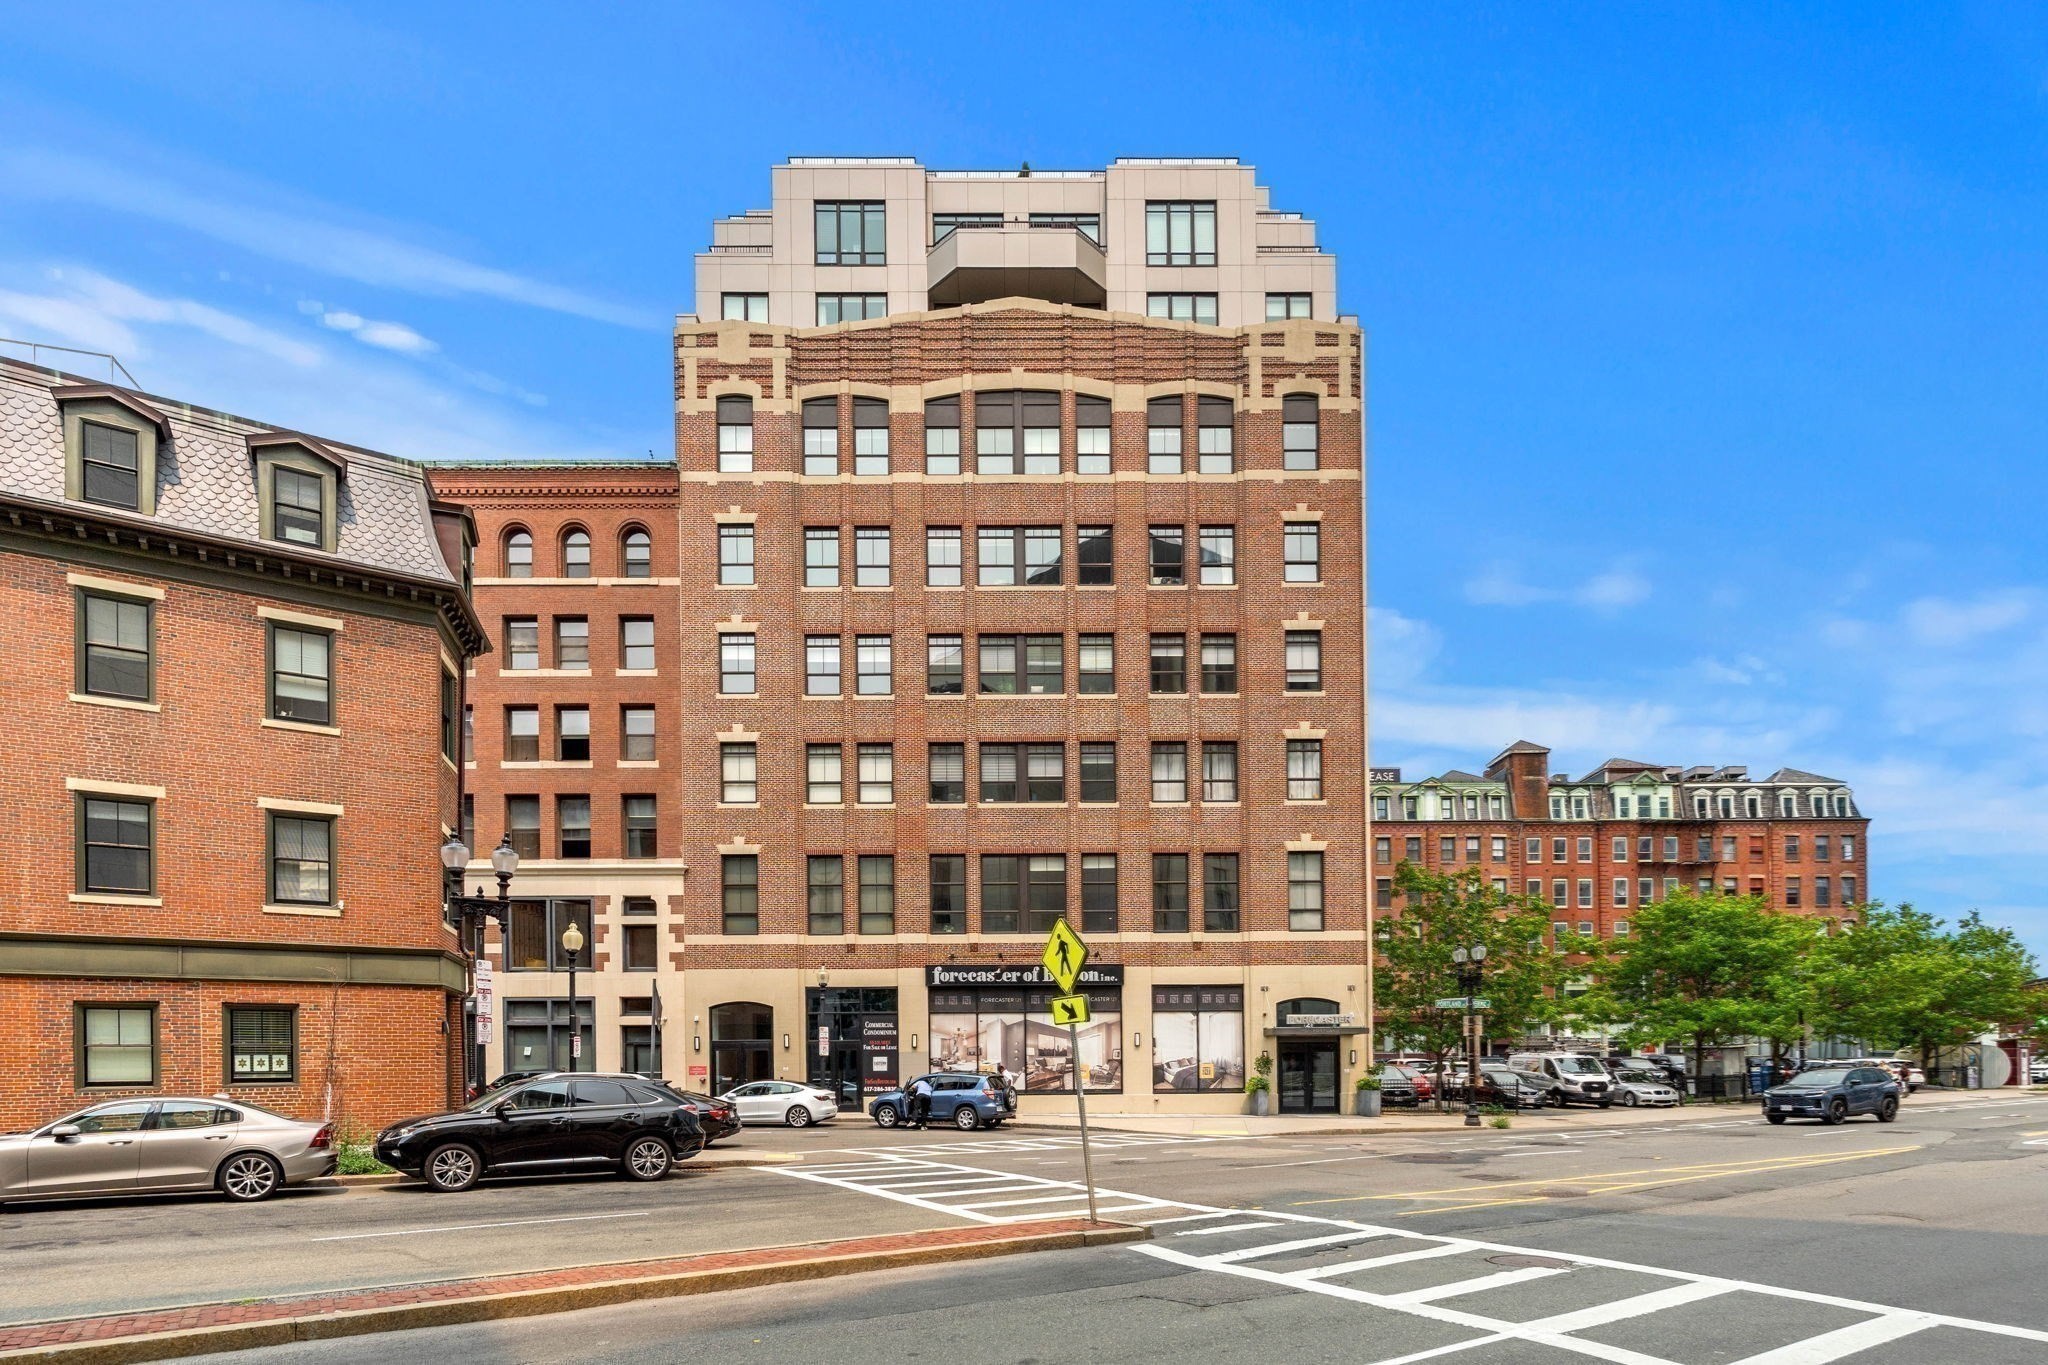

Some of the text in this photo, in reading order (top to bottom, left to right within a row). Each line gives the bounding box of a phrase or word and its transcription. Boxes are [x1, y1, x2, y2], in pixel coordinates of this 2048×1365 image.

[1369, 772, 1394, 781] EASE
[1022, 966, 1039, 982] of
[1042, 966, 1099, 982] Bon
[1100, 973, 1118, 982] inc.
[1288, 1015, 1351, 1024] FORECASTER
